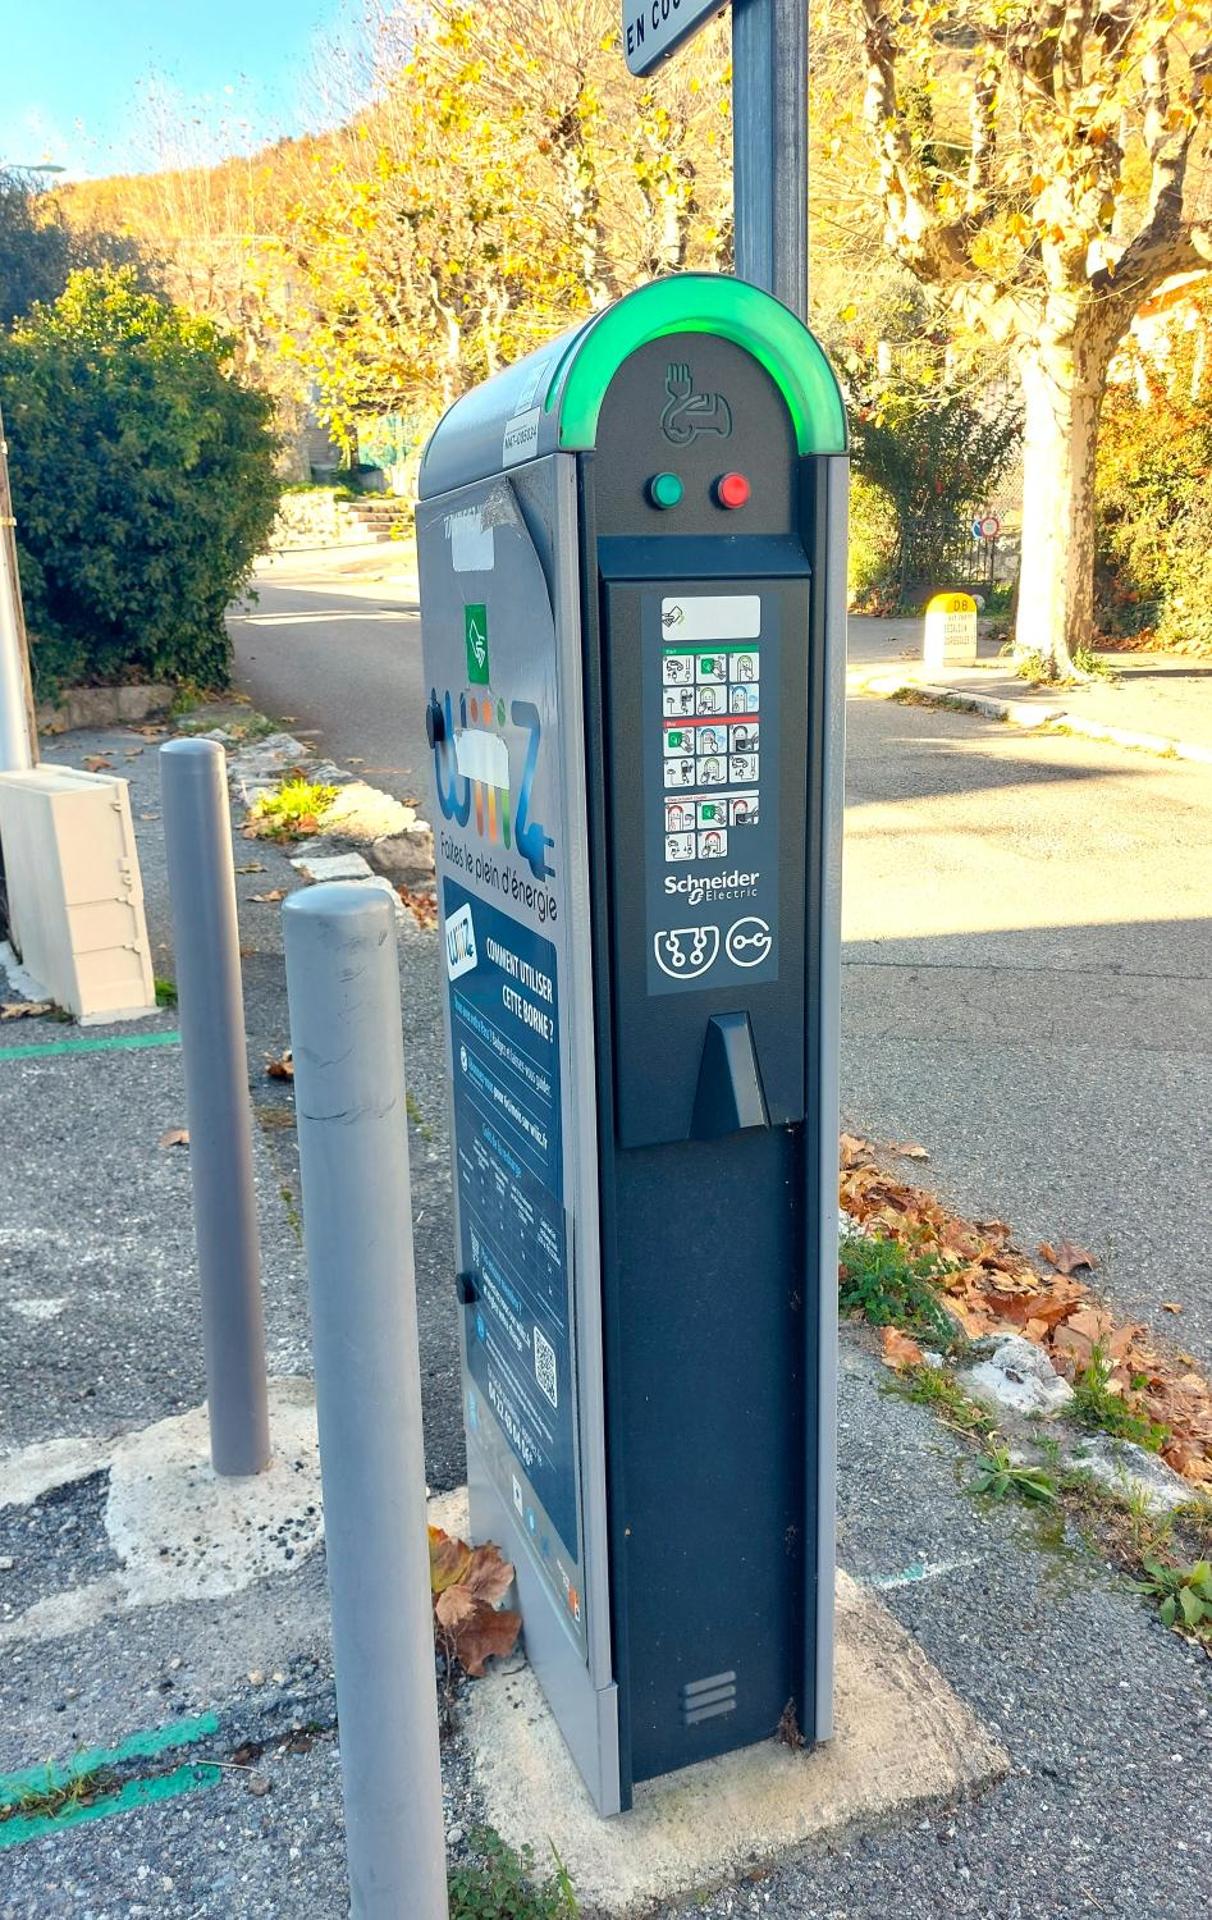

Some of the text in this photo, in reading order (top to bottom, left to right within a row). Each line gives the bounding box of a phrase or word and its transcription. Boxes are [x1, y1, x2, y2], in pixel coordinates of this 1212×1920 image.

[627, 14, 645, 56] EN
[441, 831, 558, 922] Faites le plein d'énergie
[664, 870, 760, 894] Schneider
[705, 887, 758, 902] Electric
[486, 937, 553, 1004] COMMENT UTILISER
[502, 984, 523, 1020] CETTE
[523, 998, 549, 1040] BORNE
